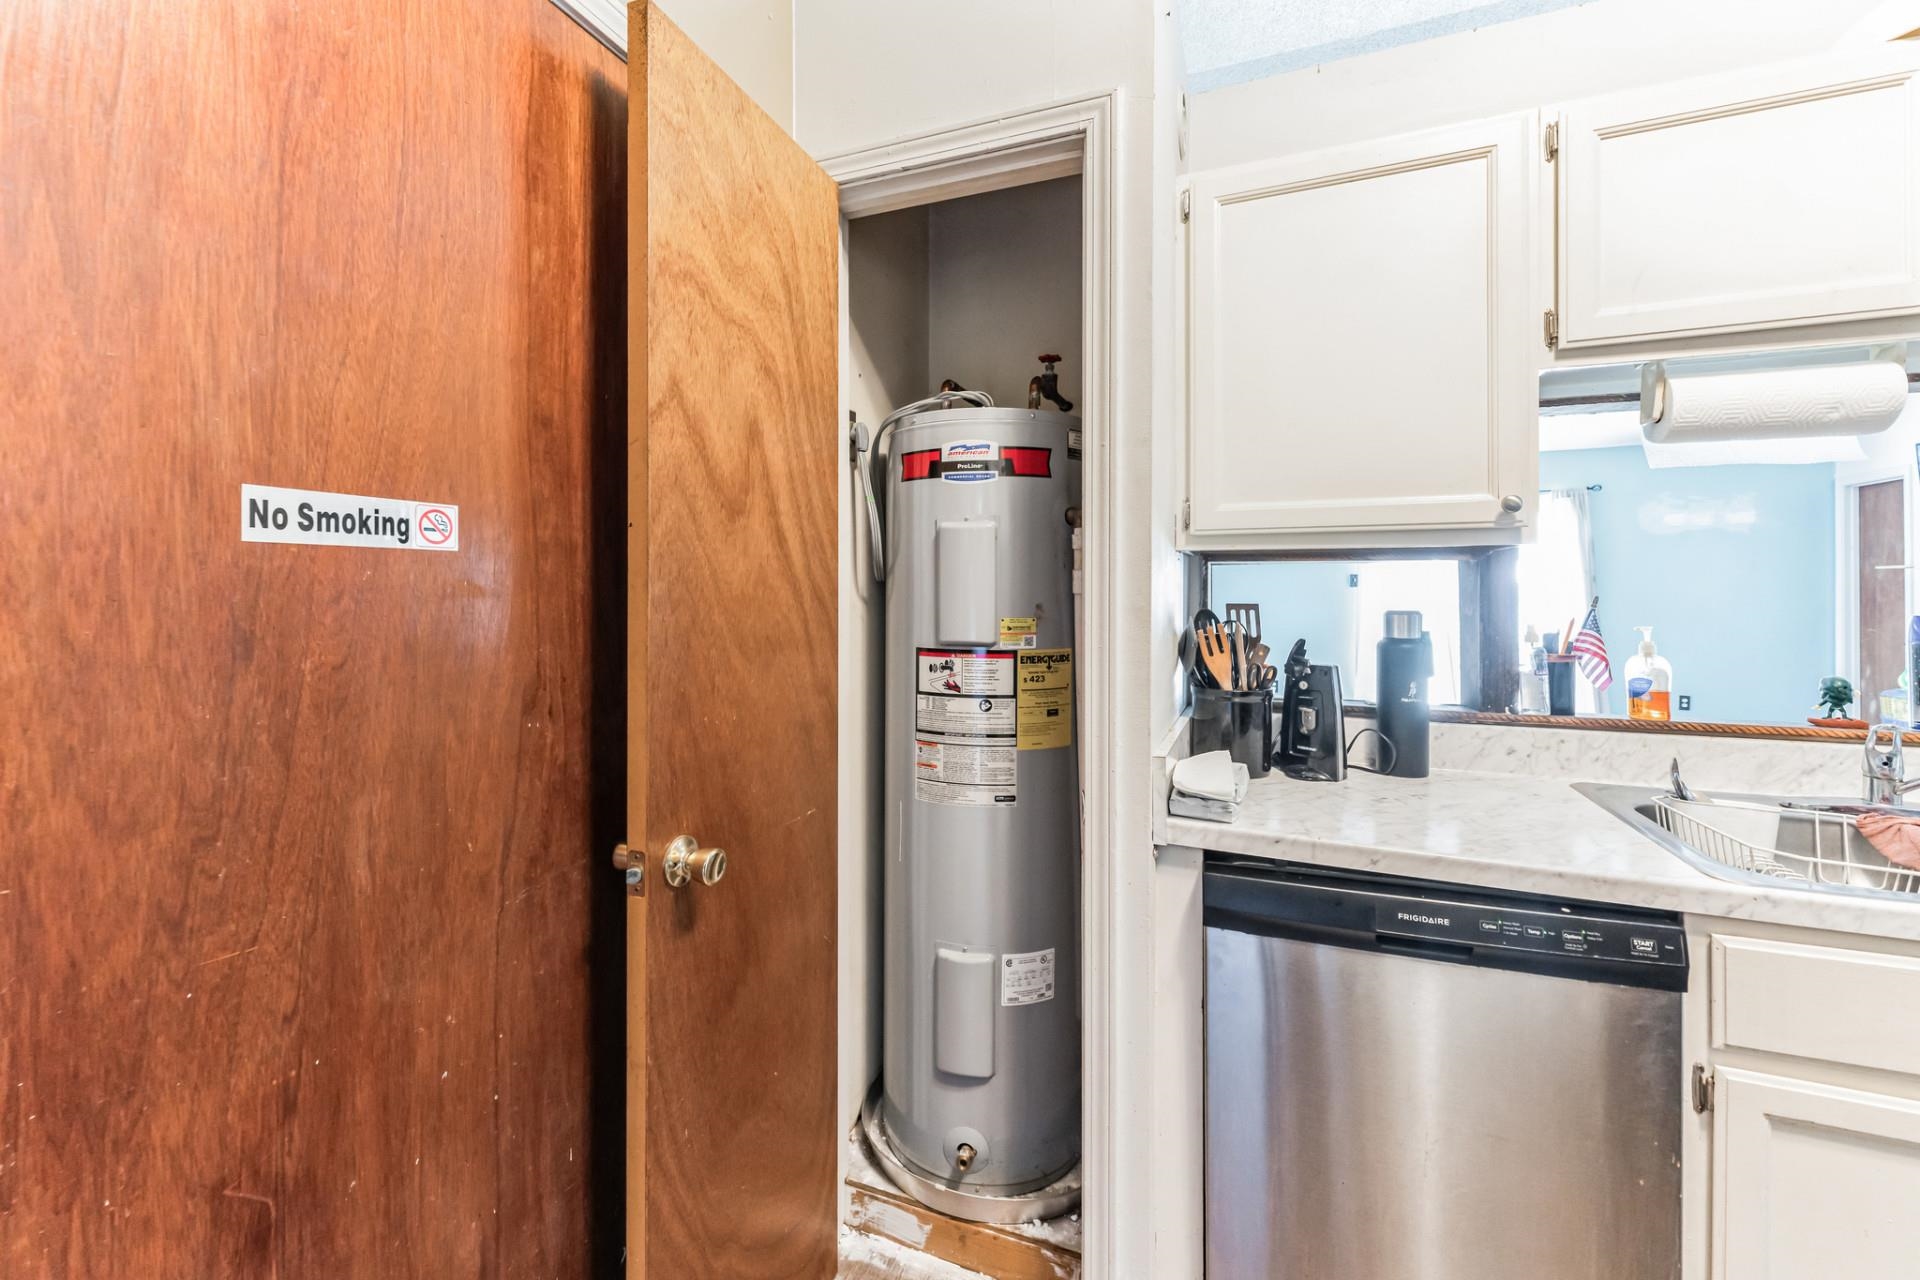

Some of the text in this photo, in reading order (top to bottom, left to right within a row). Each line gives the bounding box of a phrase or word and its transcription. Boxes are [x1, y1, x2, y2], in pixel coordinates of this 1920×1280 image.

[249, 498, 410, 544] No Smoking
[1029, 675, 1046, 683] 423
[1397, 912, 1450, 926] FRIGIDAIRE
[1633, 939, 1654, 948] START
